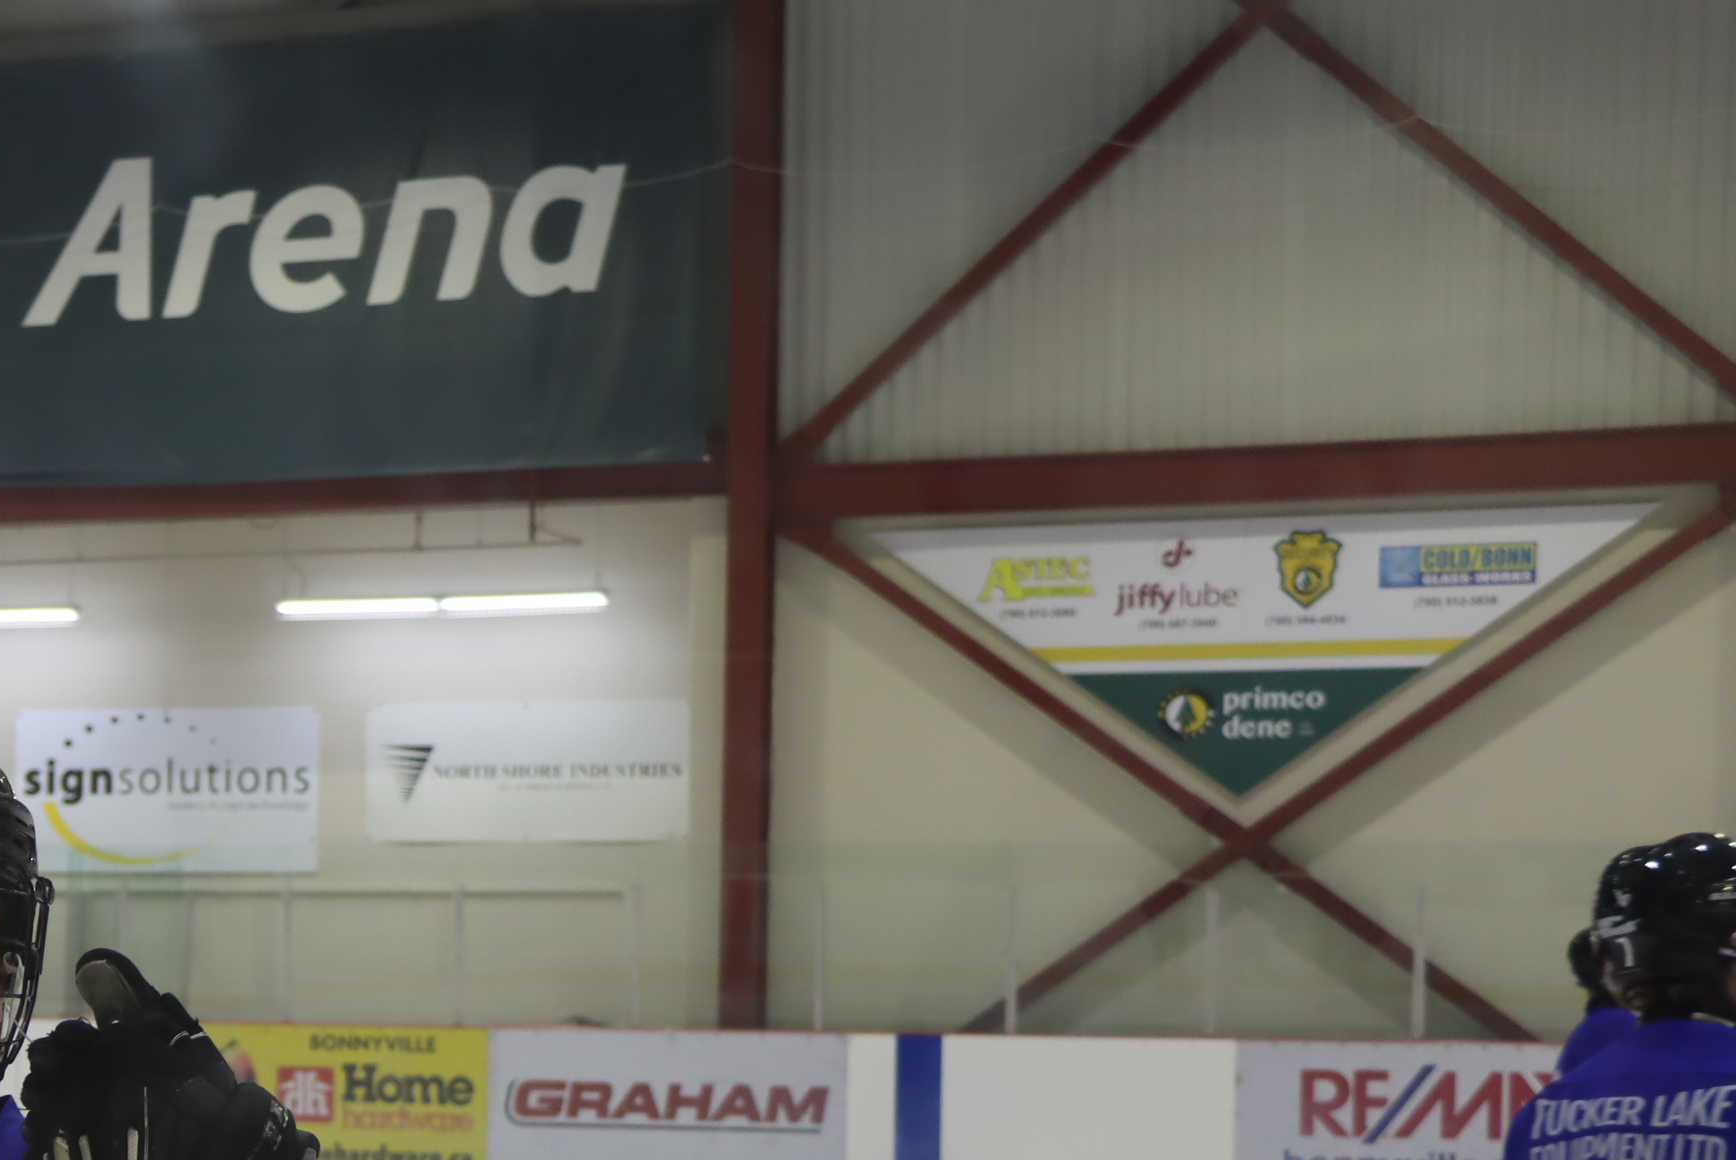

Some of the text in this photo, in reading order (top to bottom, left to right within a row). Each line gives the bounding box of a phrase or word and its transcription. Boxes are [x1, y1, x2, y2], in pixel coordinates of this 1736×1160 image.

[21, 156, 627, 328] Arena
[1222, 685, 1326, 716] primco
[1221, 714, 1293, 740] dene
[432, 762, 683, 779] NORTH SHORE INDUSTRIES
[309, 1035, 436, 1053] BONNYVILLE
[342, 1063, 474, 1106] Home
[514, 1079, 830, 1126] GRAHAM
[342, 1106, 475, 1132] hardware
[1299, 1064, 1558, 1145] RE/M
[1530, 1085, 1736, 1141] TUCKER LAKE
